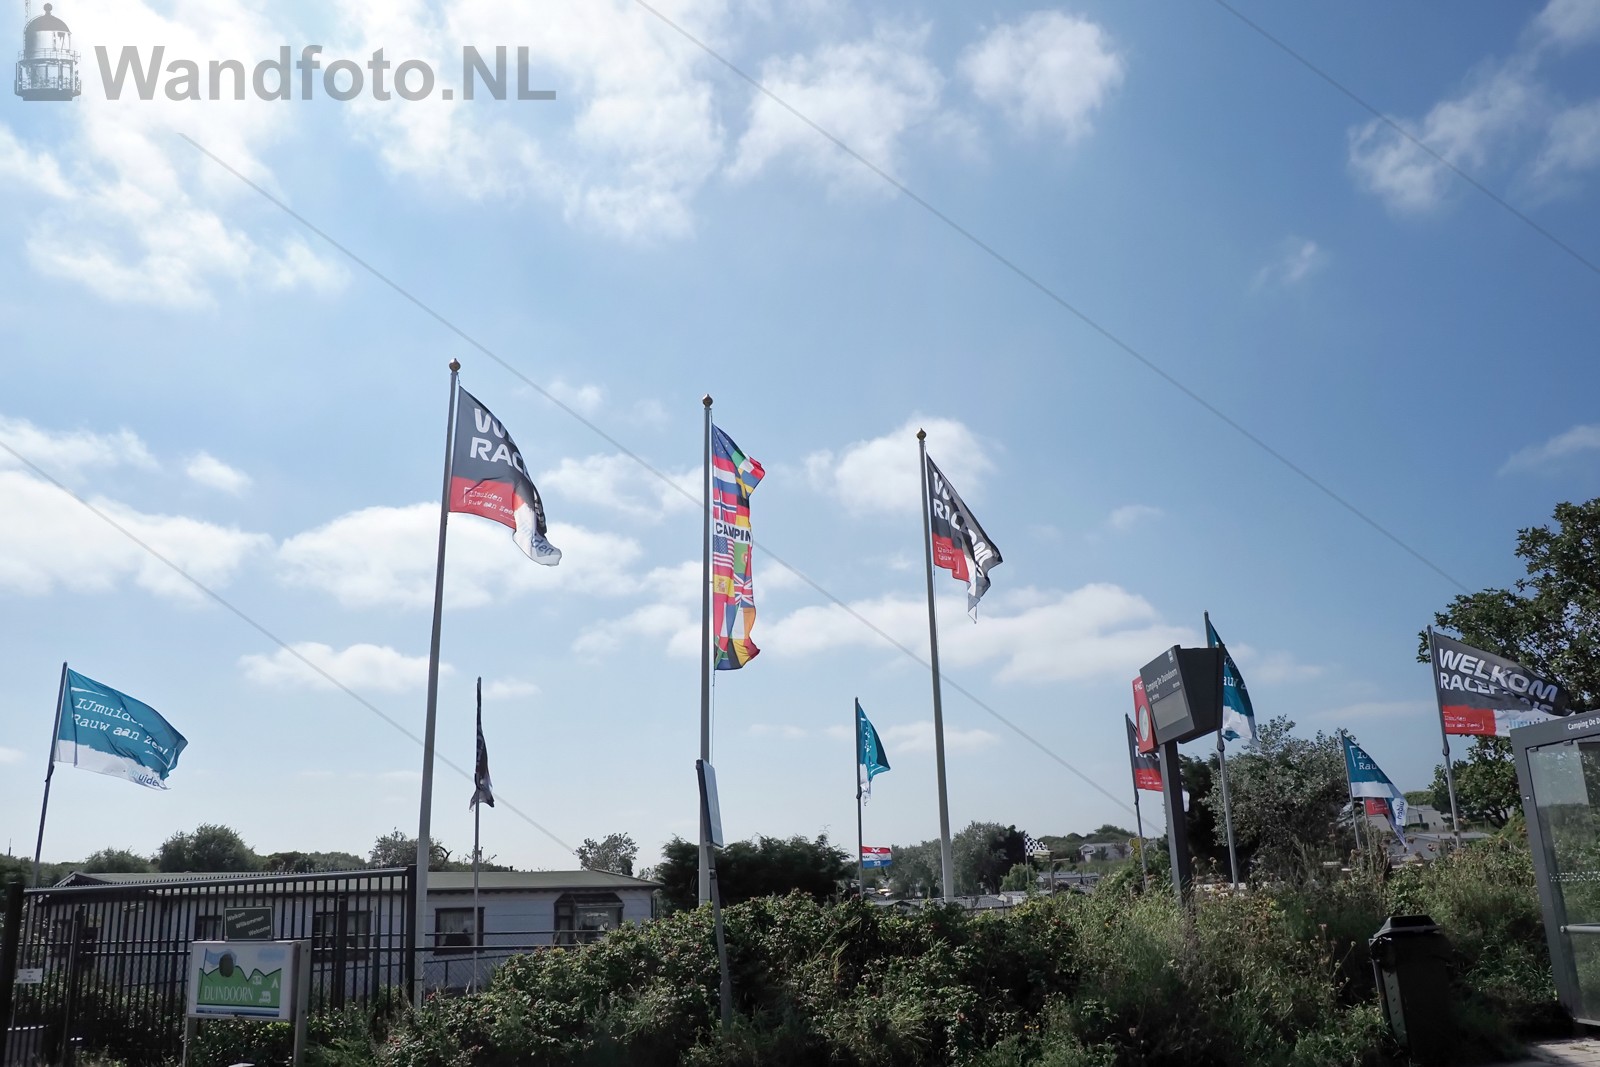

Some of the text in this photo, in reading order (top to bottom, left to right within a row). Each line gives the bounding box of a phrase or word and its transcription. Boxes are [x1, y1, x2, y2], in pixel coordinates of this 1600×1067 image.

[1439, 648, 1558, 702] WELKOM
[71, 714, 110, 731] Rauw
[113, 726, 140, 741] aan
[1567, 720, 1589, 731] Camping
[226, 911, 246, 922] Welkom
[248, 925, 271, 937] Welcome
